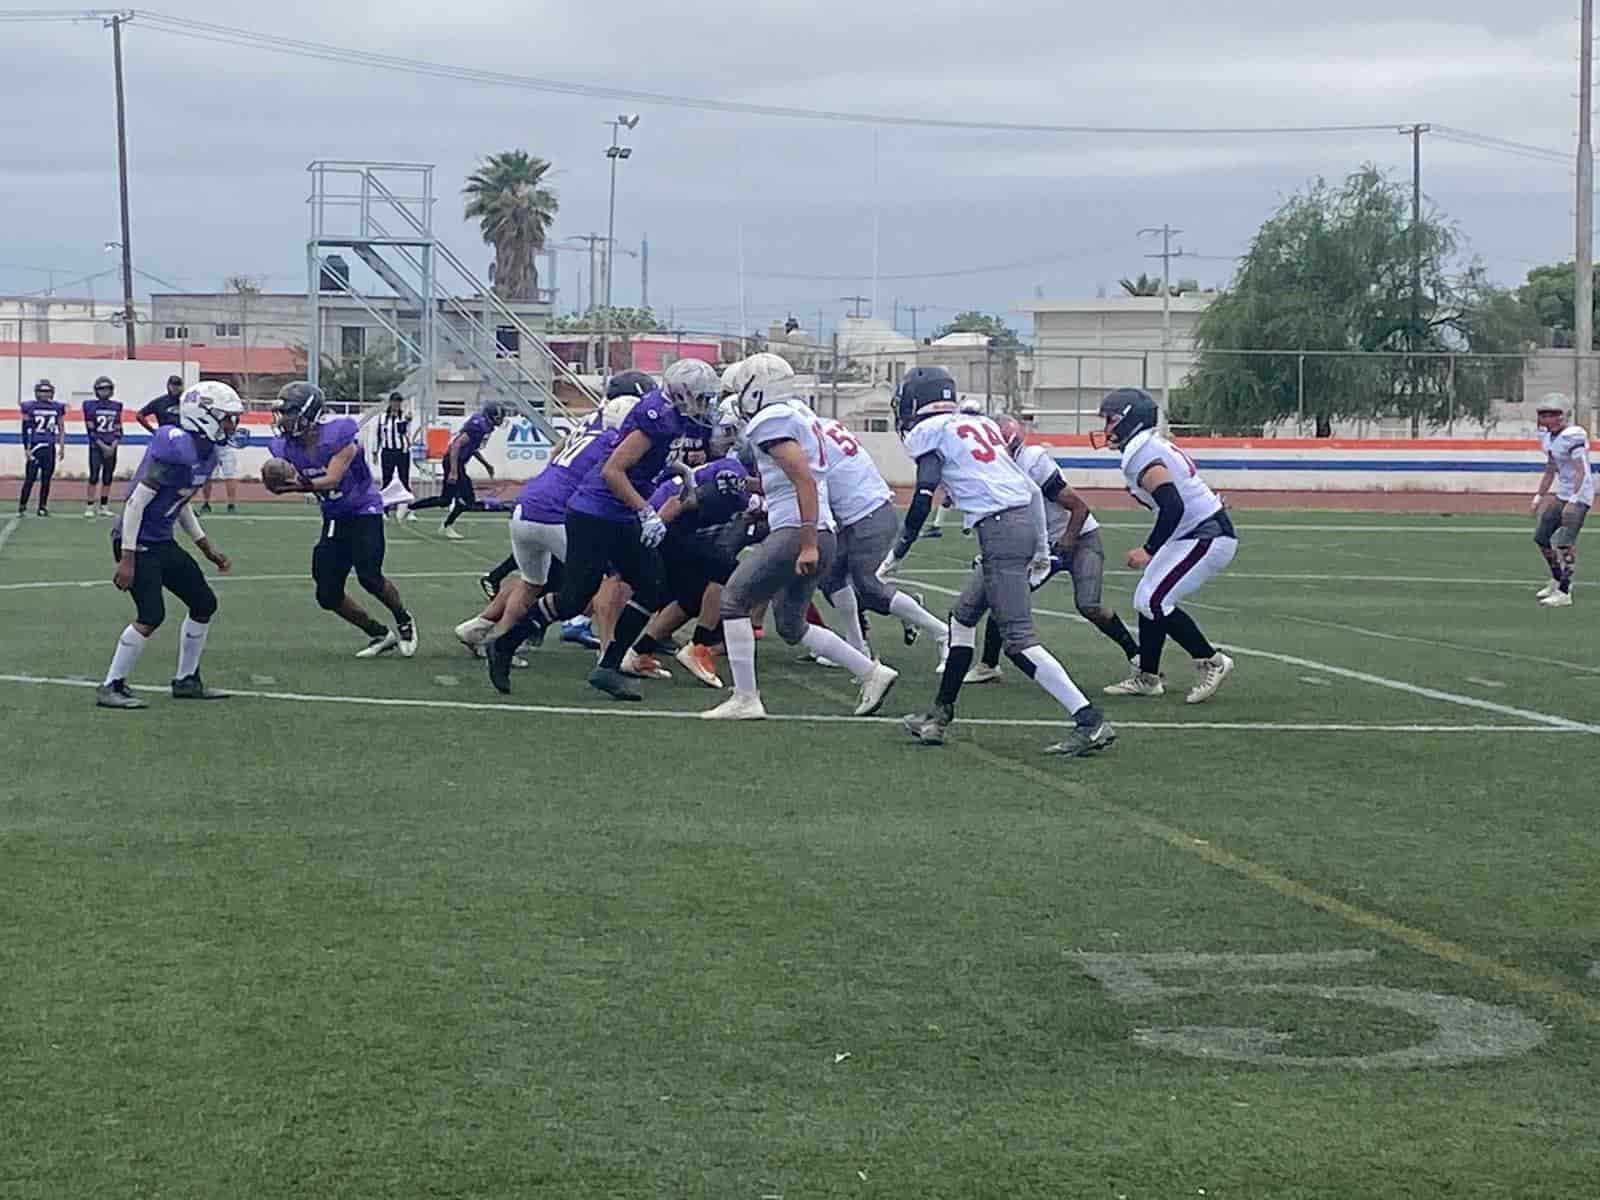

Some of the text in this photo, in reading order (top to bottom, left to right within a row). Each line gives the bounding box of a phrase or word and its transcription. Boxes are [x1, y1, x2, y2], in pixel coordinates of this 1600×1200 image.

[34, 415, 59, 433] 24
[957, 421, 1003, 463] 34
[1060, 946, 1555, 1070] 5
